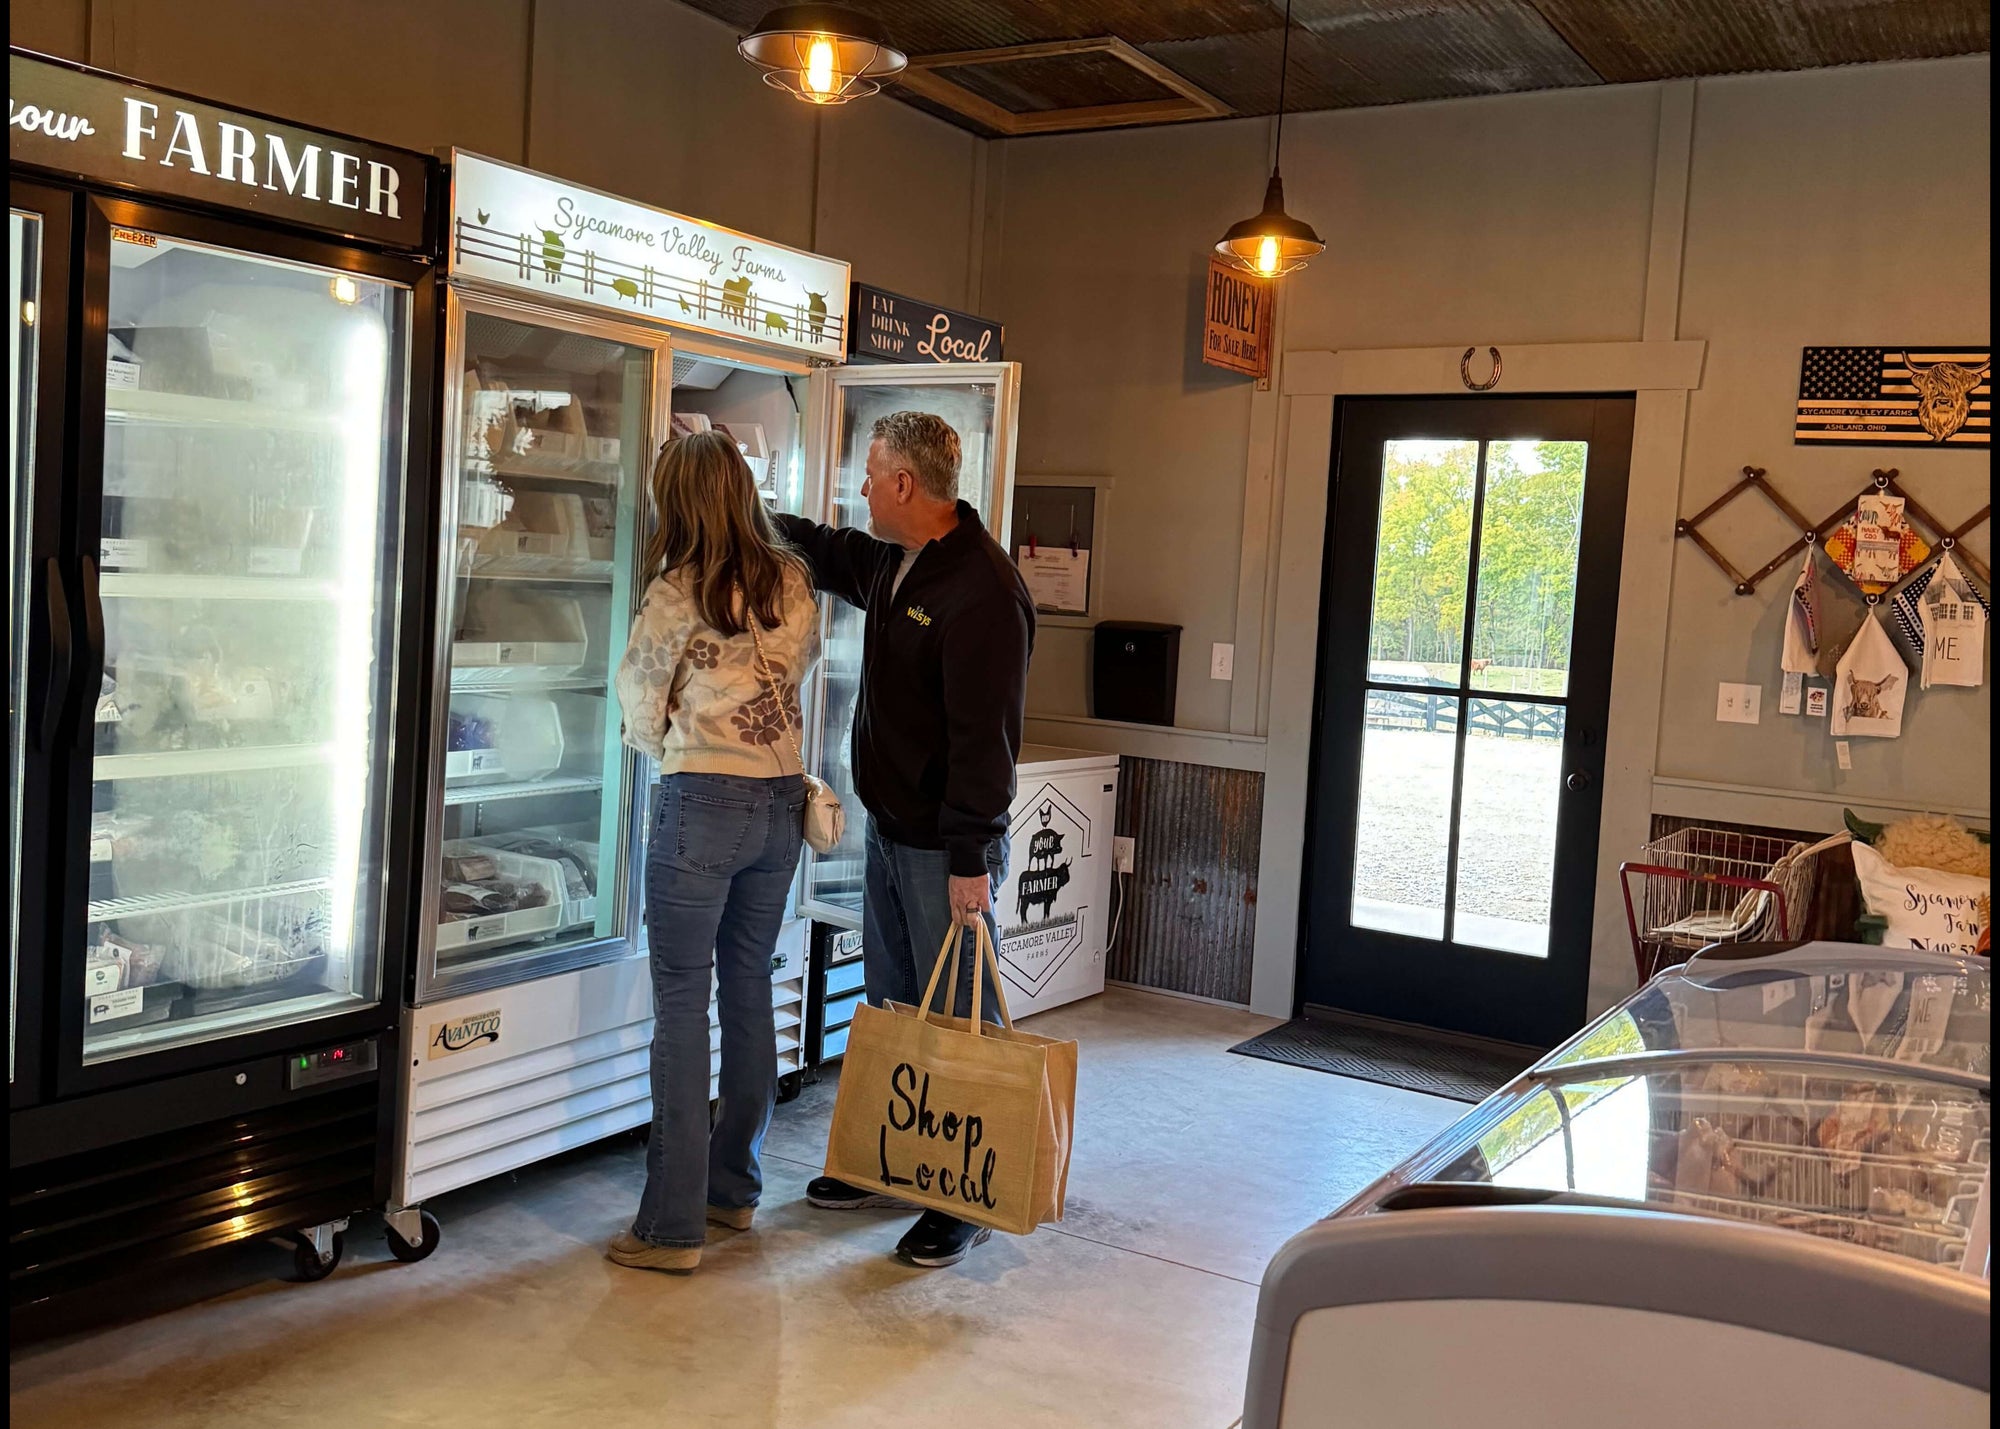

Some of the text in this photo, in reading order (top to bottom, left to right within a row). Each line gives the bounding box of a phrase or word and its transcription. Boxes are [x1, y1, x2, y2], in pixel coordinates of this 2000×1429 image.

[122, 97, 401, 219] FARMER
[113, 228, 156, 246] FREEZER
[554, 197, 786, 283] Sycamore Valley Farms
[872, 294, 895, 315] EAT
[1210, 271, 1260, 334] HONEY
[871, 314, 910, 337] DRINK
[917, 313, 991, 363] Local
[871, 333, 904, 353] SHOP
[1824, 424, 1886, 432] ASHLAND, OHIO
[1934, 636, 1960, 661] ME.
[1022, 876, 1058, 896] FARMER
[1904, 884, 1979, 915] Sycamore
[1000, 926, 1075, 955] SYCAMORE VALLEY
[1026, 948, 1049, 960] FARMS
[888, 1063, 983, 1173] Shop
[880, 1124, 996, 1209] Local
